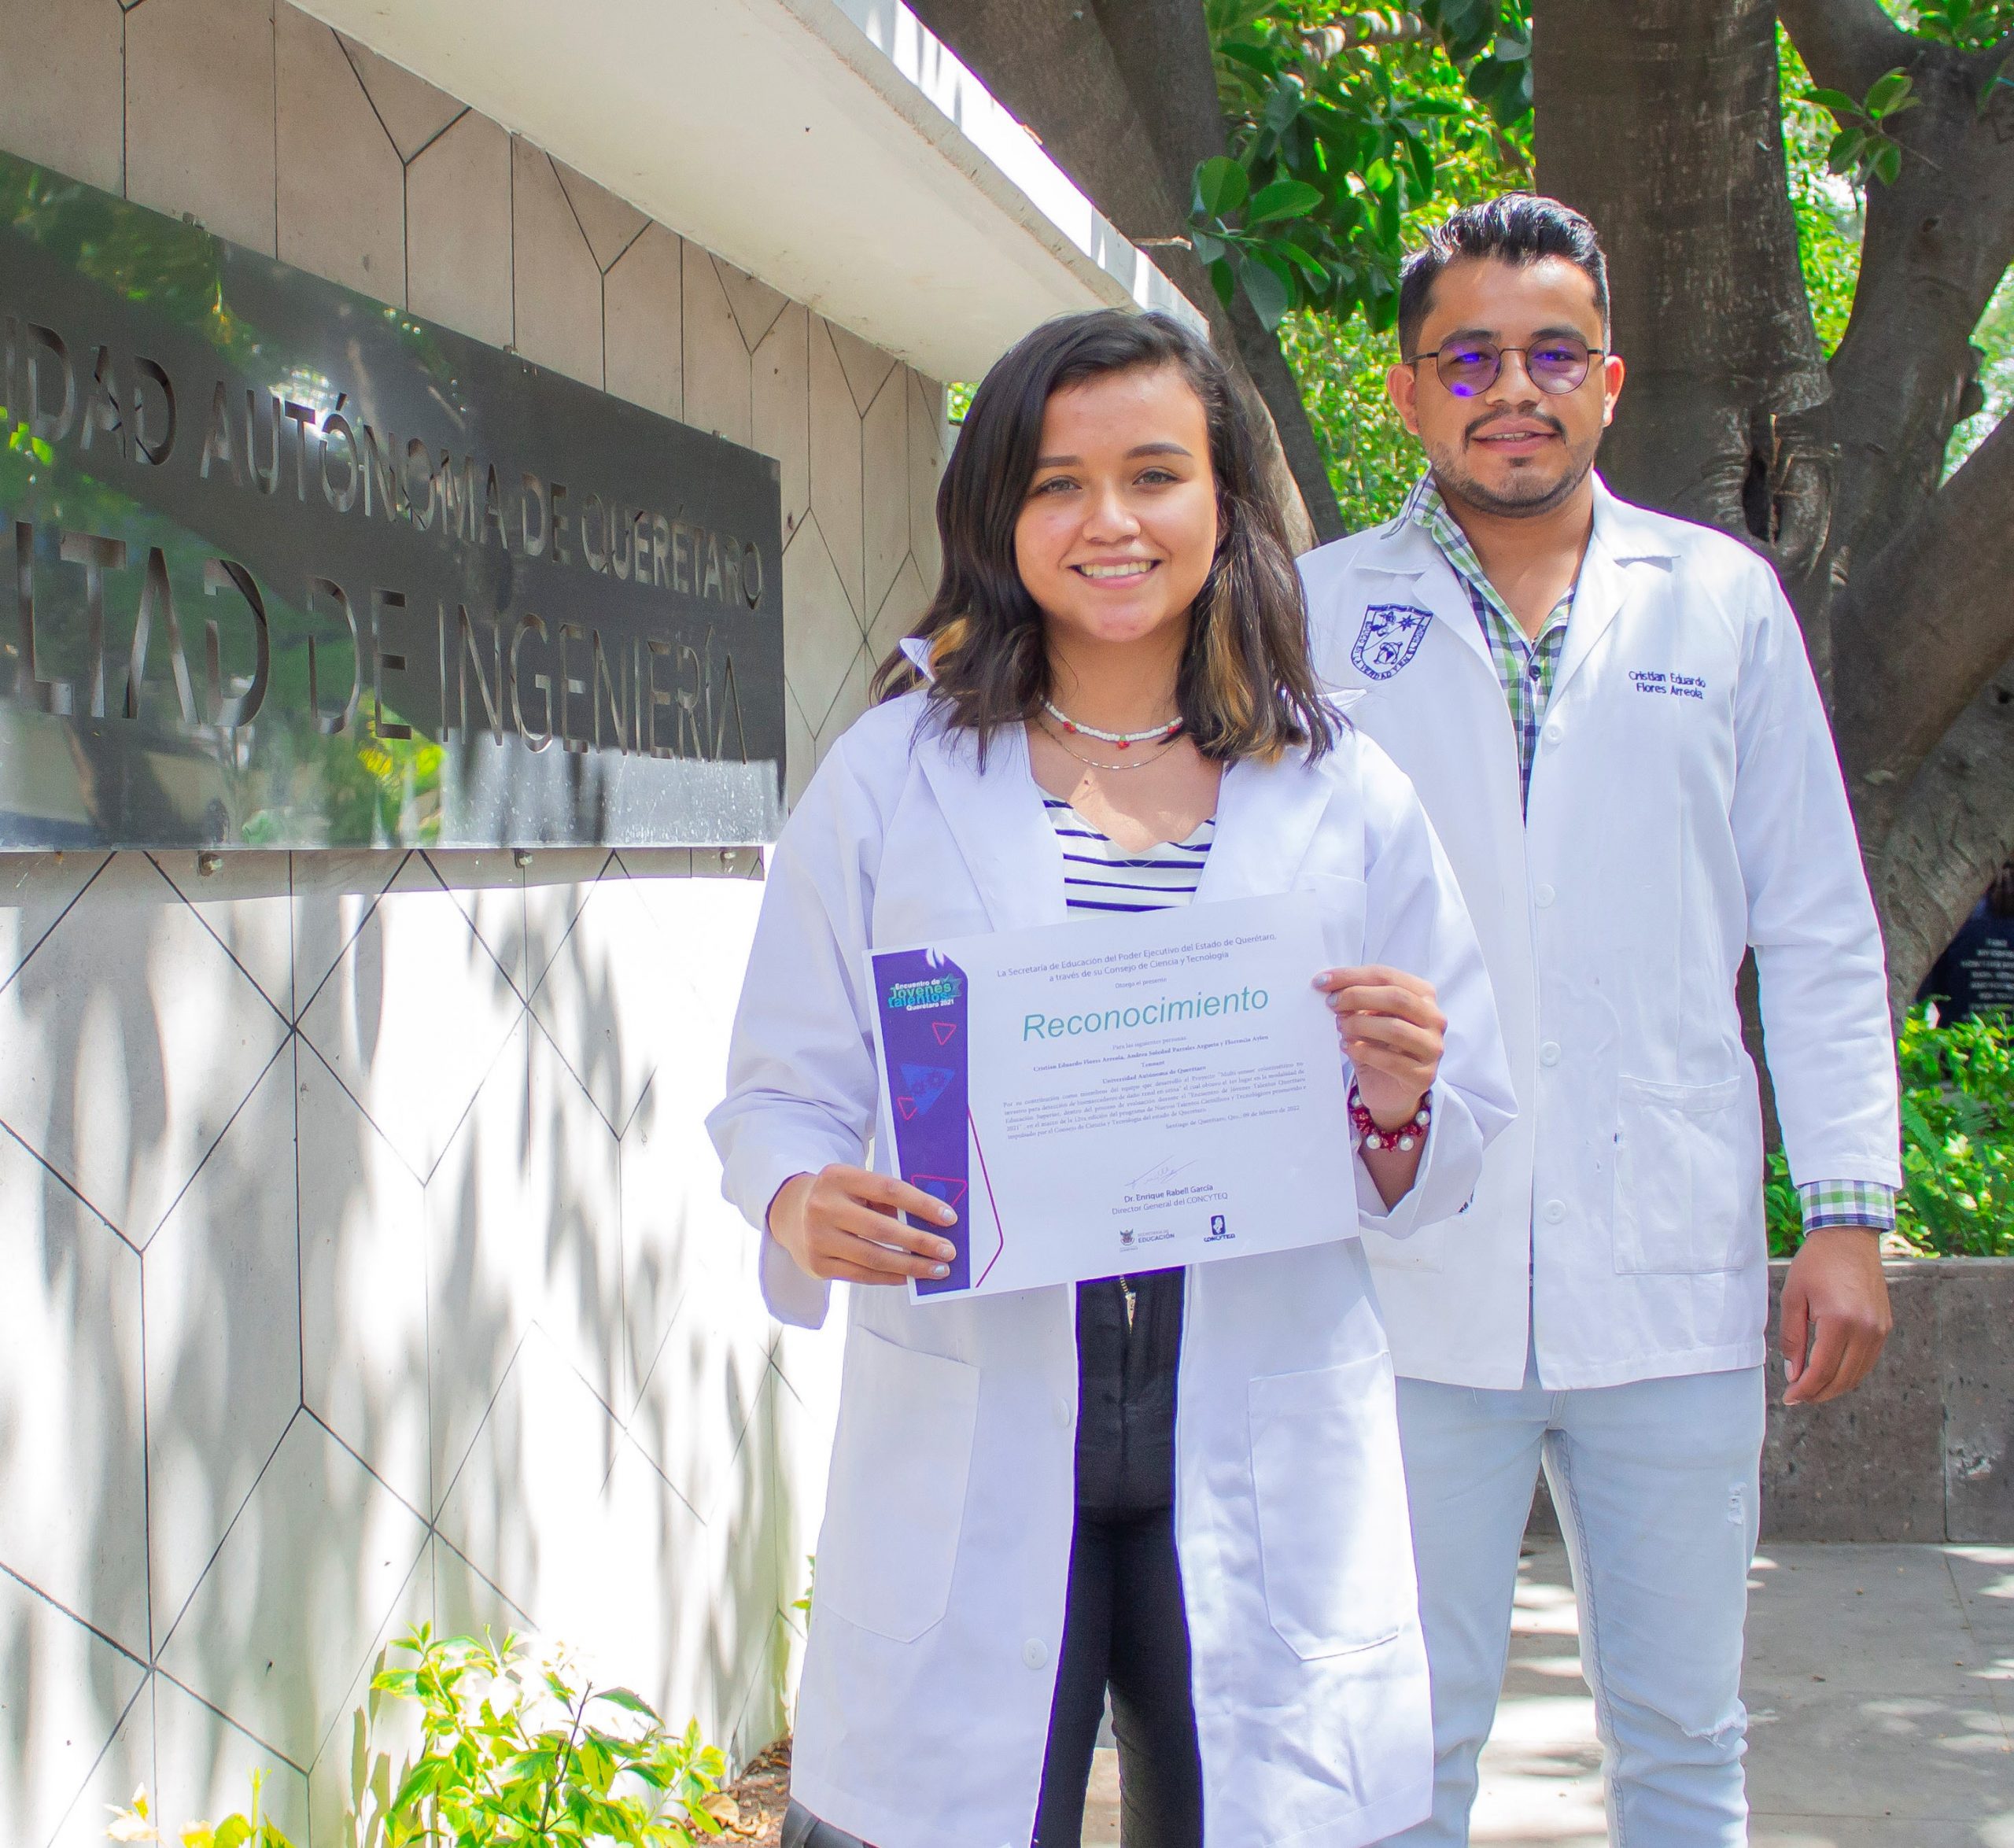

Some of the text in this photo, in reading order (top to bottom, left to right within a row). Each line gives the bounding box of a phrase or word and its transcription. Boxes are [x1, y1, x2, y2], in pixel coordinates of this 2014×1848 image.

[200, 381, 508, 549] AUTÓNOMA
[521, 473, 572, 566] DE
[581, 493, 763, 610] QUERÉTARO
[307, 575, 413, 740] DE
[438, 603, 747, 765] INGENIERÍA
[1629, 670, 1706, 688] Cristian Eduardo
[1636, 682, 1704, 699] Flores Arreola
[1009, 965, 1047, 976] Secretaría
[1062, 957, 1102, 968] Educación
[1105, 954, 1116, 963] del
[1119, 952, 1142, 961] Poder
[1144, 946, 1179, 959] Ejecutivo
[1182, 943, 1193, 953] del
[1196, 940, 1222, 950] Estado
[1057, 972, 1079, 981] través
[1105, 964, 1135, 975] Consejo
[1150, 958, 1179, 968] Ciencia
[1187, 951, 1229, 963] Tecnología
[940, 998, 954, 1007] 2021
[1024, 986, 1268, 1042] Reconocimiento
[1112, 1206, 1142, 1215] Director
[1143, 1201, 1172, 1211] General
[1186, 1192, 1228, 1204] CONCYTEQ
[1137, 1193, 1164, 1201] Enrique
[1166, 1187, 1189, 1197] Rabell
[1190, 1184, 1213, 1193] García
[1138, 1233, 1175, 1244] EDUCACIÓN
